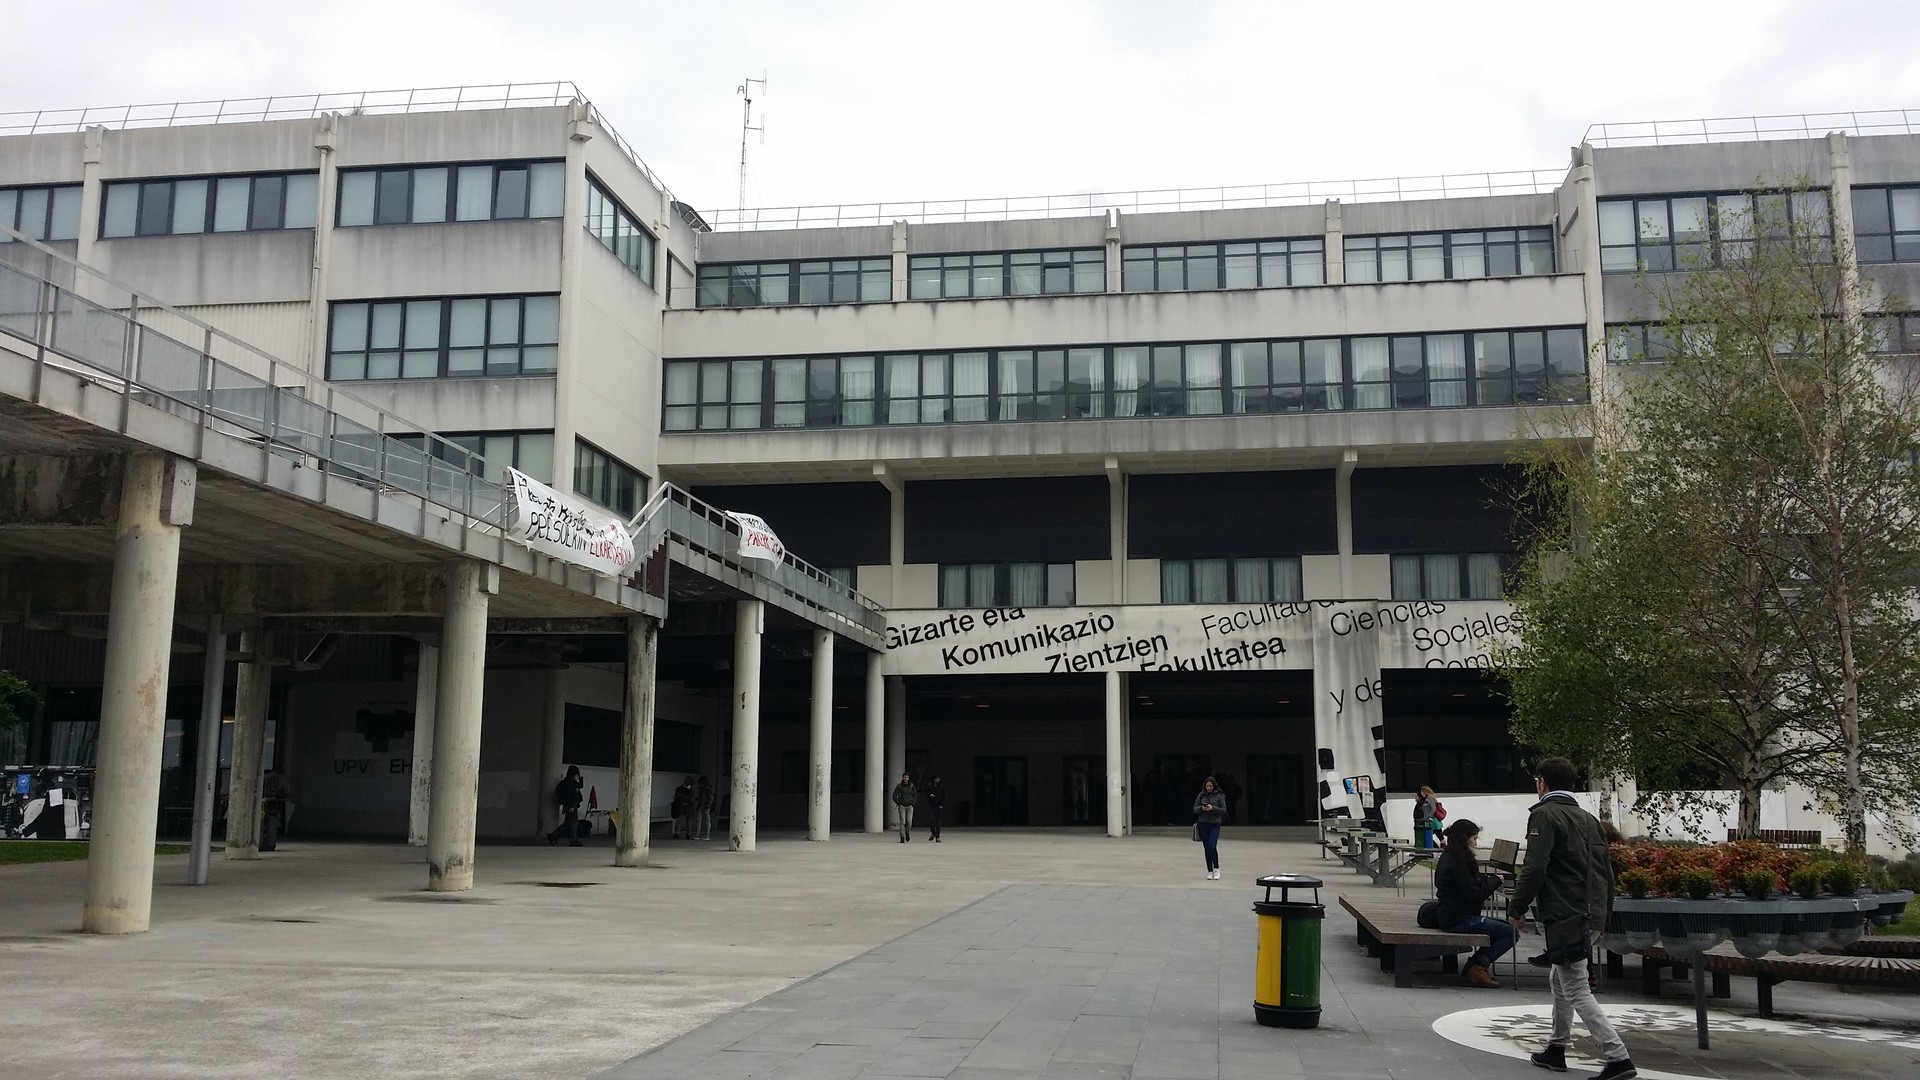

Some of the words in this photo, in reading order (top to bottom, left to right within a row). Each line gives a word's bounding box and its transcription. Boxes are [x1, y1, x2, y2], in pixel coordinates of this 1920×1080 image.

[885, 613, 975, 650] Gizarte
[1330, 600, 1446, 636] Ciencias
[1412, 612, 1526, 652] Sociales
[941, 612, 1115, 670] Komunikazio
[1044, 634, 1169, 673] Zientzien
[1329, 688, 1345, 714] y
[1354, 677, 1383, 703] de
[333, 758, 370, 775] UPV
